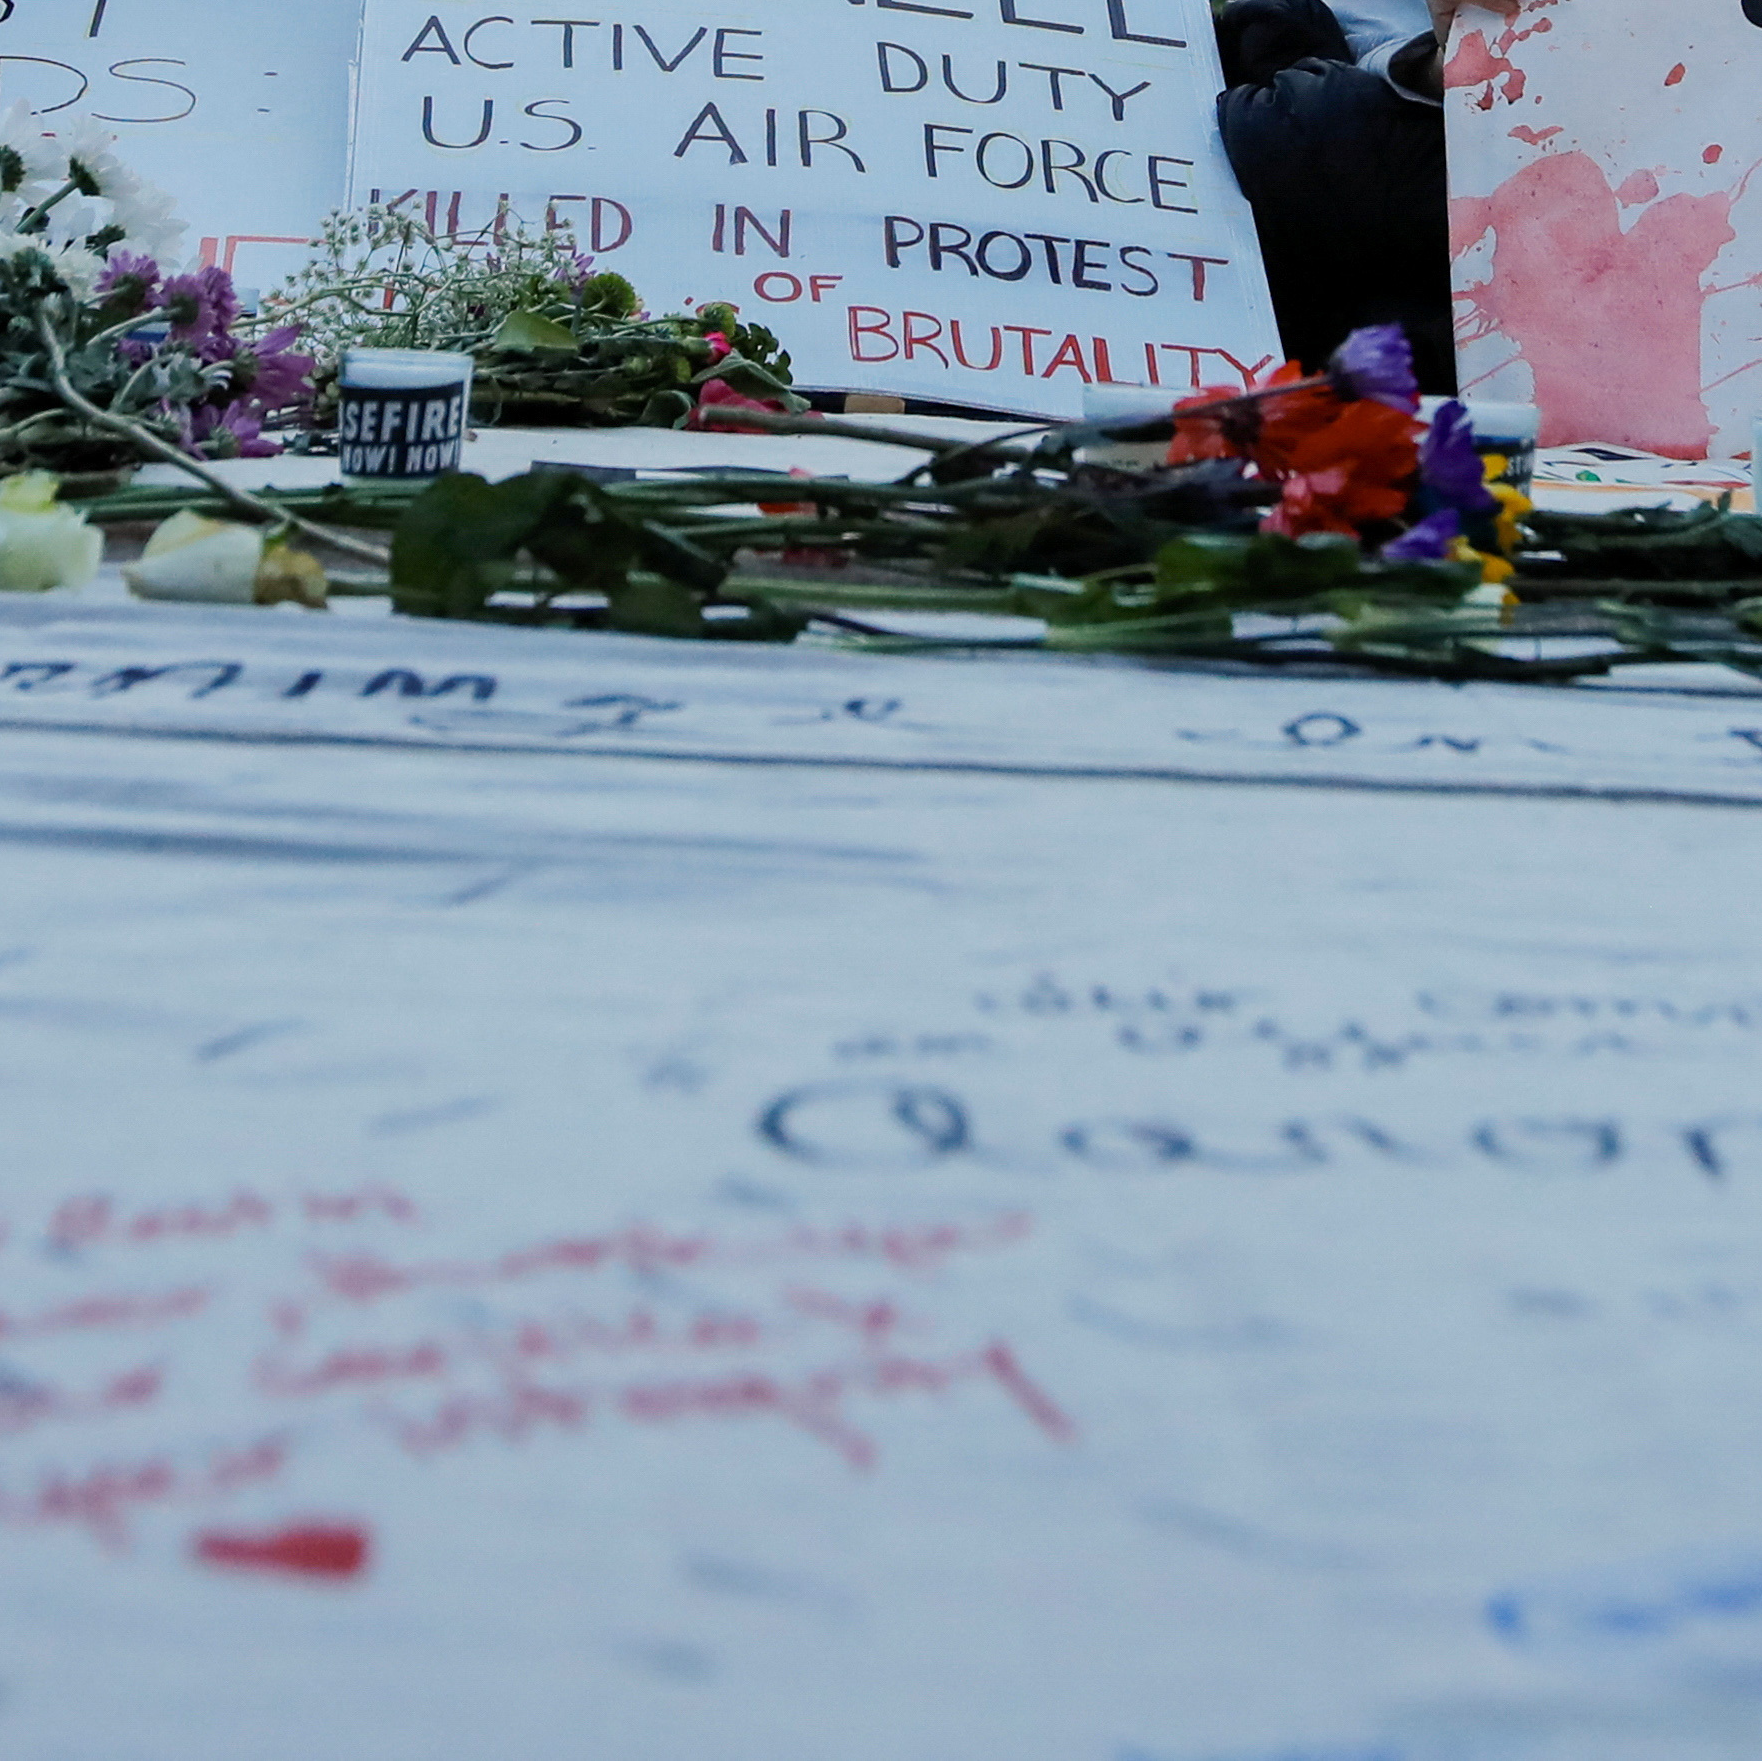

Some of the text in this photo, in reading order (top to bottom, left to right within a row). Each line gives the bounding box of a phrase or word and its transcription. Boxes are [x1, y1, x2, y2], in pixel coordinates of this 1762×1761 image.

[402, 15, 1152, 122] ACTIVE DUTY
[421, 94, 1199, 214] U.S. AIR FORCE
[711, 202, 791, 258] IN
[884, 216, 1229, 302] PROTEST
[753, 271, 844, 304] OF
[846, 305, 1275, 392] BRUTALITY
[339, 395, 461, 442] SEFIRE
